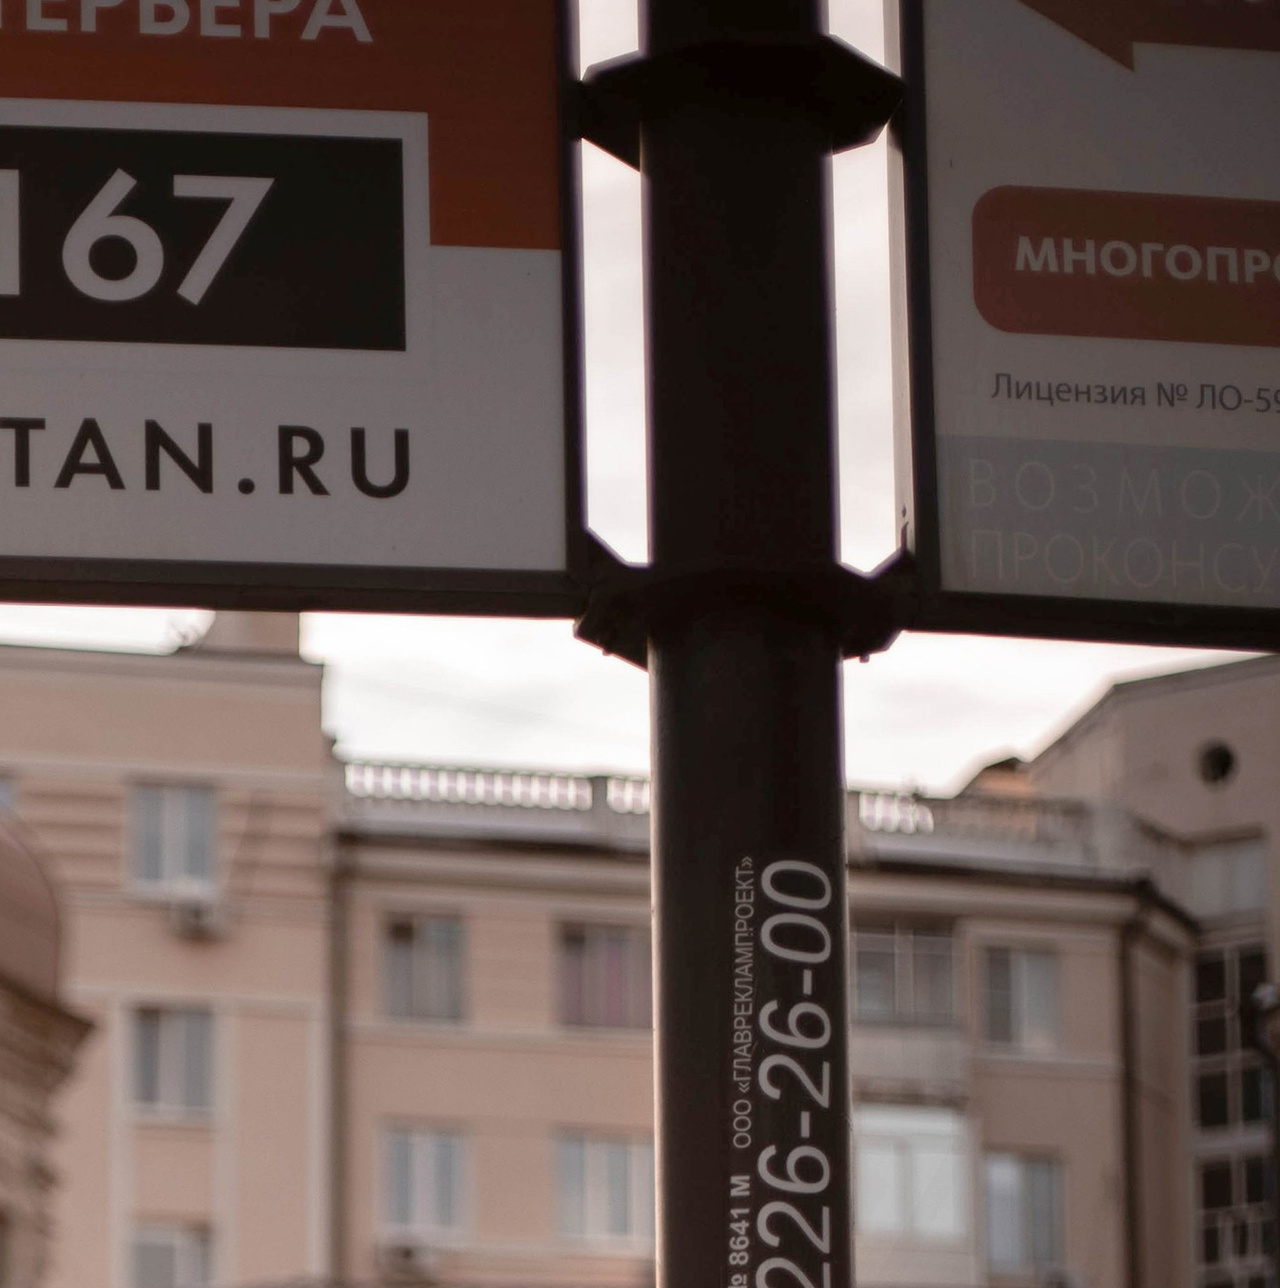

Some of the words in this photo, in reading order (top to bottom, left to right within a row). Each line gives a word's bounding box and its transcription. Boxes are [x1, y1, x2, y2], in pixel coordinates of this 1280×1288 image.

[1014, 235, 1280, 287] МНОГОПР
[991, 372, 1146, 407] Лицензия
[1157, 381, 1188, 408] №
[732, 1099, 753, 1149] ООО
[729, 1174, 751, 1199] М
[728, 1204, 751, 1266] 8641
